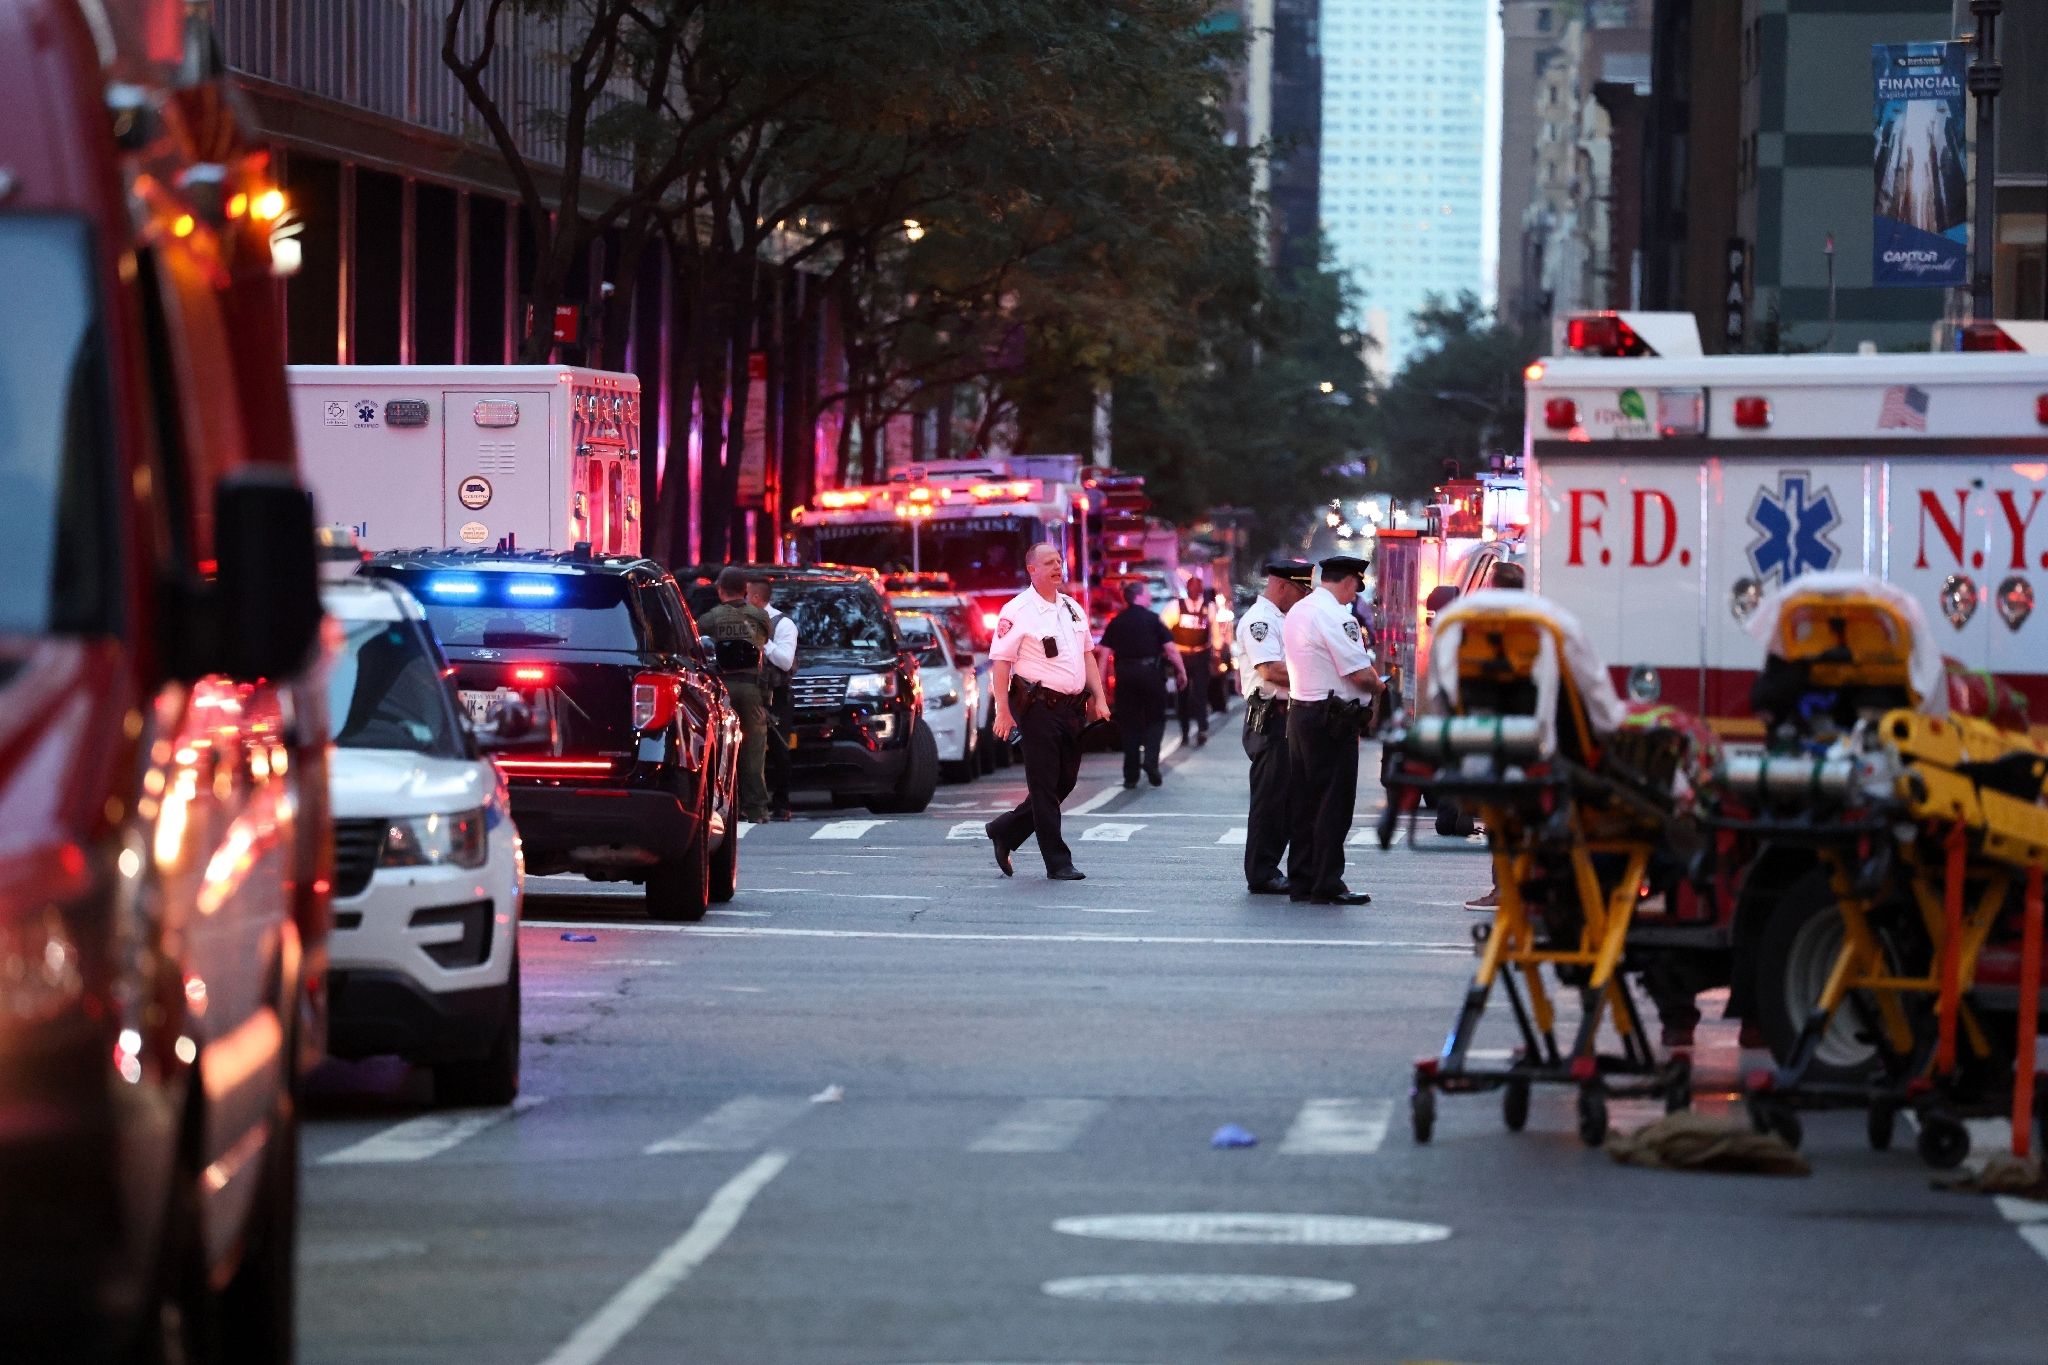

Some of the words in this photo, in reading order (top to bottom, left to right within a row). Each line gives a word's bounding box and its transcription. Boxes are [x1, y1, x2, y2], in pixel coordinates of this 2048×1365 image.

[1878, 76, 1960, 90] FINANCIAL
[1878, 89, 1907, 99] Capital
[1919, 88, 1933, 97] the
[1883, 250, 1938, 263] CANTOR
[1567, 487, 1691, 568] F.D.
[1914, 487, 2048, 571] N.Y.
[718, 623, 758, 637] POLICE
